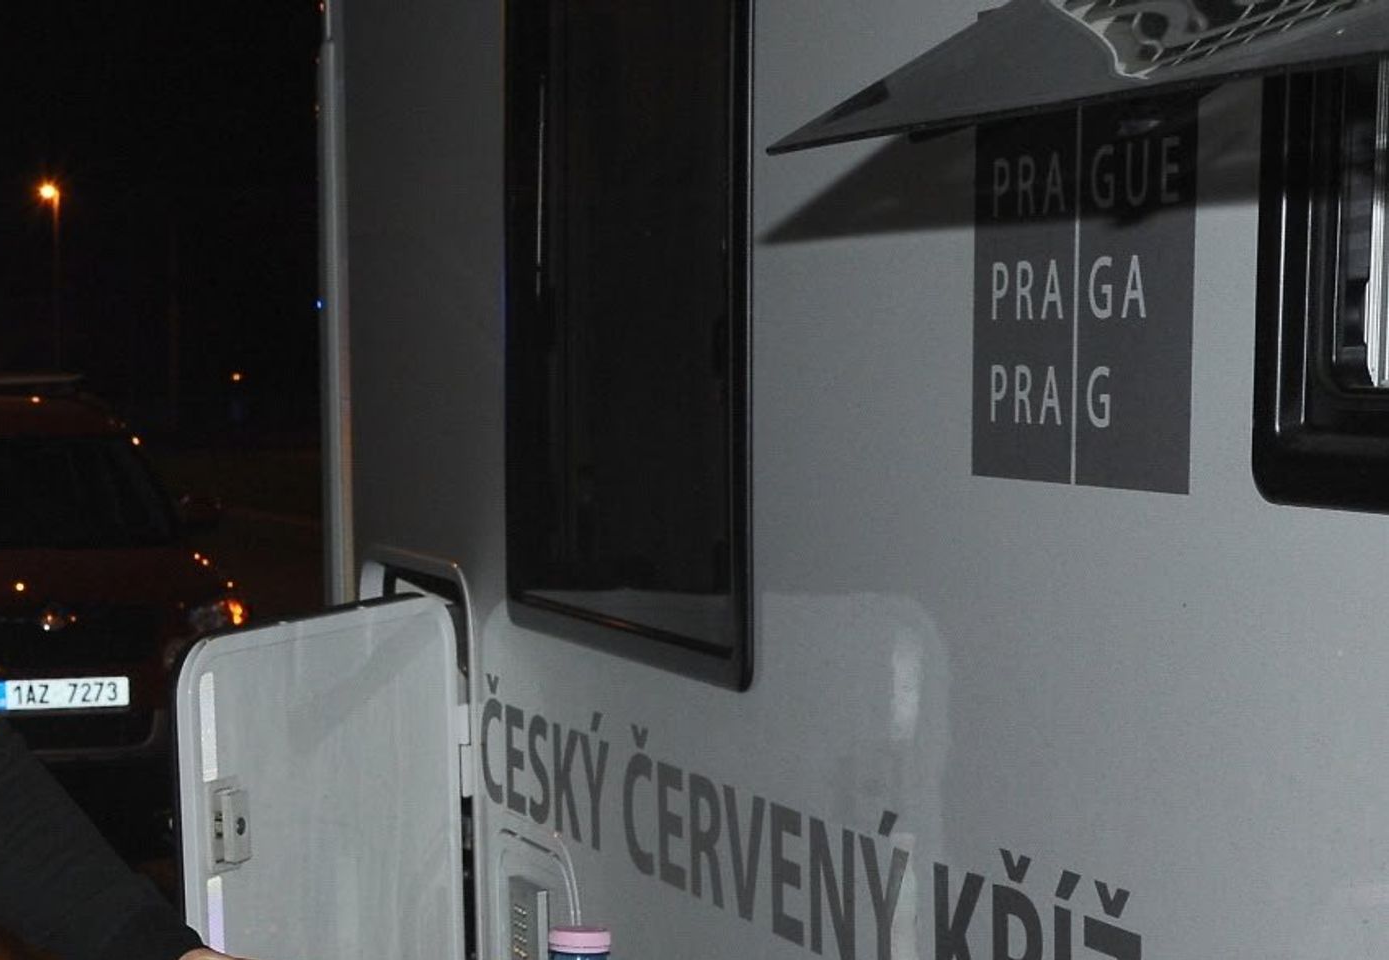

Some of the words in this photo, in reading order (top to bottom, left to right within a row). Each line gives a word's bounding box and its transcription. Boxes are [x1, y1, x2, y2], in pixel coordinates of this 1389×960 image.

[13, 683, 50, 705] 1AZ
[68, 681, 118, 703] 7273
[481, 673, 609, 852] ČESKÝ
